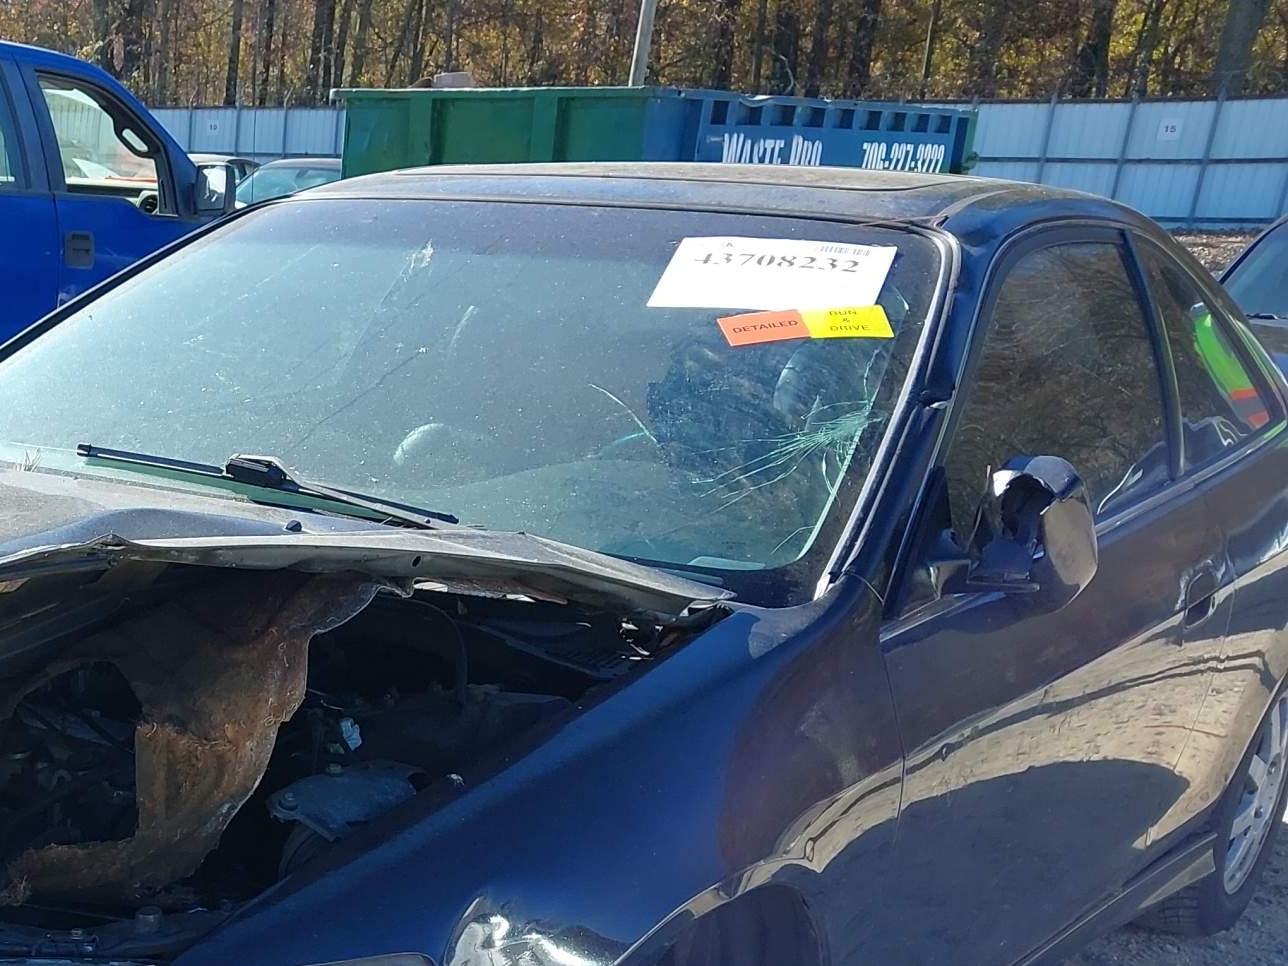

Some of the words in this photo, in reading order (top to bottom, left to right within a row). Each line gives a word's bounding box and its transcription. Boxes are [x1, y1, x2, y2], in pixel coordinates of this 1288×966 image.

[694, 252, 860, 273] 43708232
[732, 319, 799, 334] DETAILED
[829, 324, 871, 332] DRIVE
